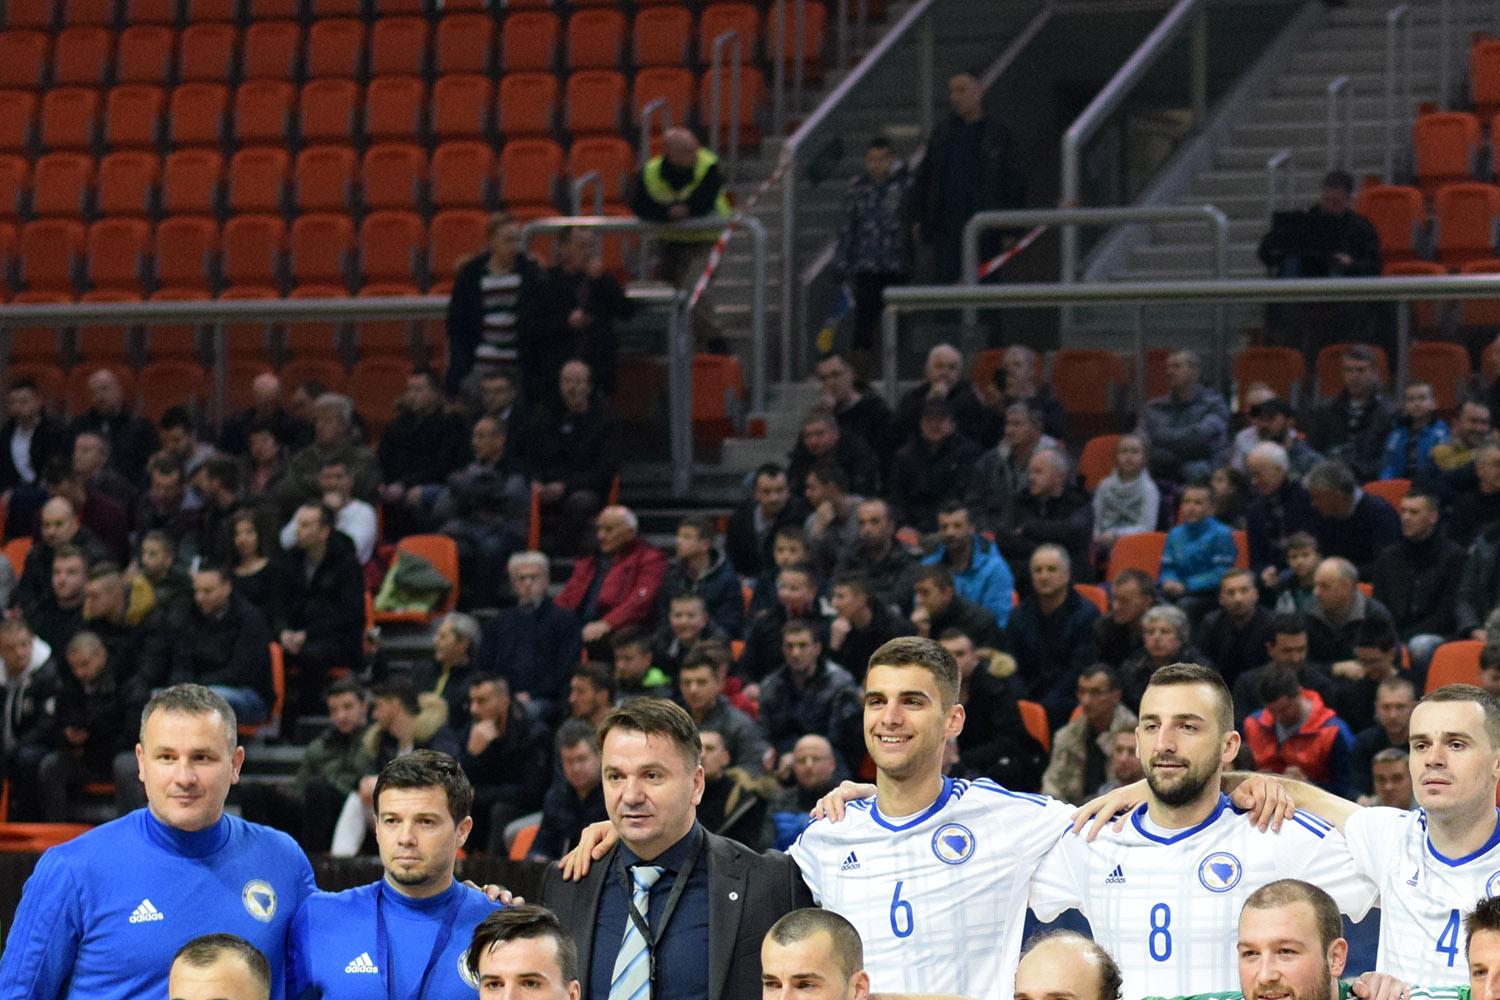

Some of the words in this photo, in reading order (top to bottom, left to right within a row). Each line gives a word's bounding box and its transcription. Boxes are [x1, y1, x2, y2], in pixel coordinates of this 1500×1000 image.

[129, 911, 164, 924] adidas
[890, 881, 914, 938] 6
[1148, 903, 1172, 962] 8
[1436, 908, 1460, 967] 4
[344, 965, 378, 974] adidas
